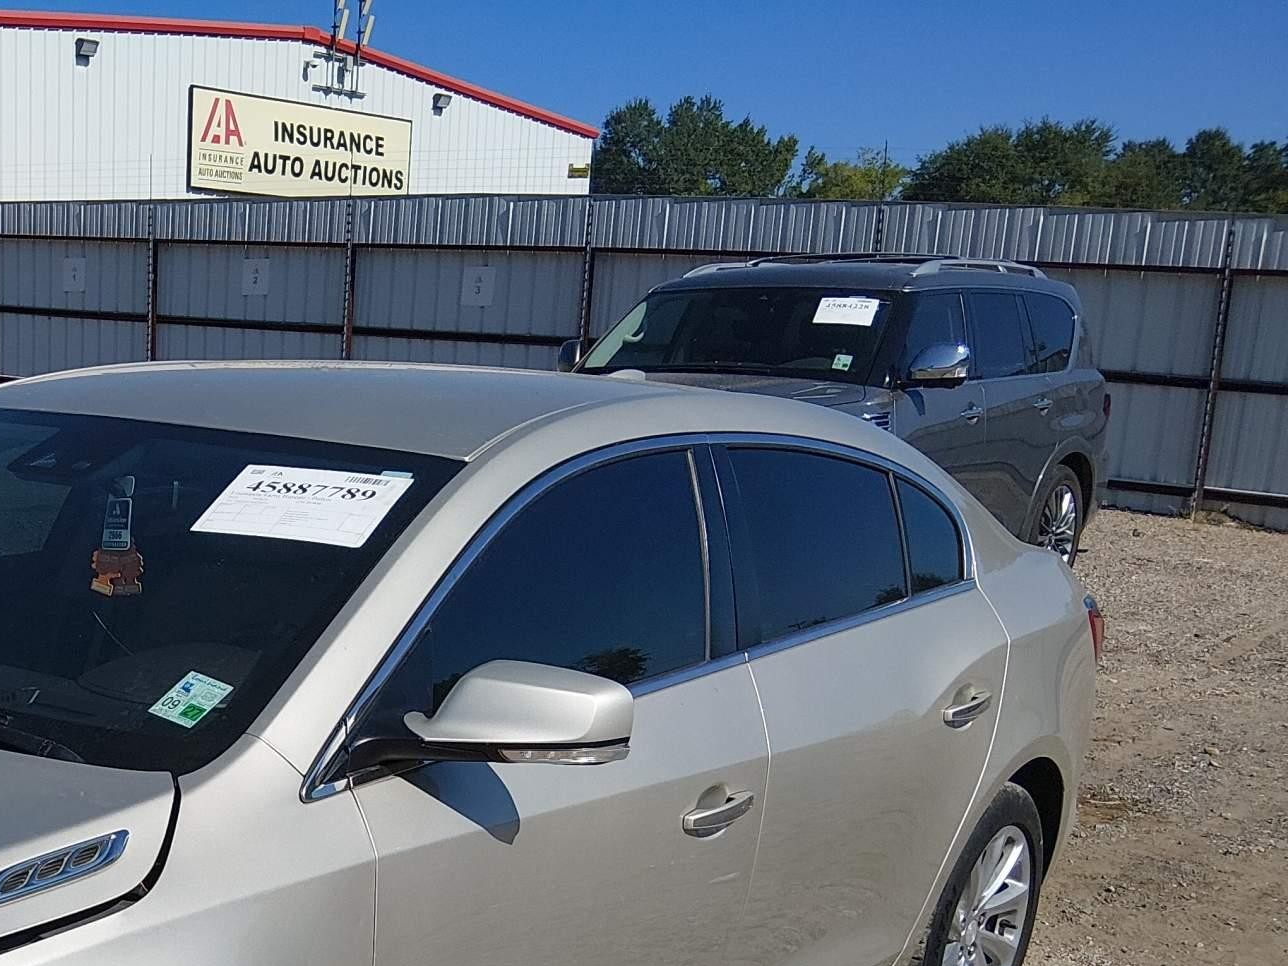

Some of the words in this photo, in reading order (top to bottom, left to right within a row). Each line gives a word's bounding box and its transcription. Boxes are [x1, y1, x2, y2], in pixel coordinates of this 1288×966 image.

[273, 120, 385, 157] INSURANCE
[198, 152, 244, 166] INSURANCE
[198, 167, 213, 177] AUTO
[214, 168, 243, 181] AUCTIONS
[248, 151, 304, 178] AUTO
[310, 159, 404, 191] AUCTIONS
[246, 480, 377, 501] 45887789
[161, 696, 181, 710] 09
